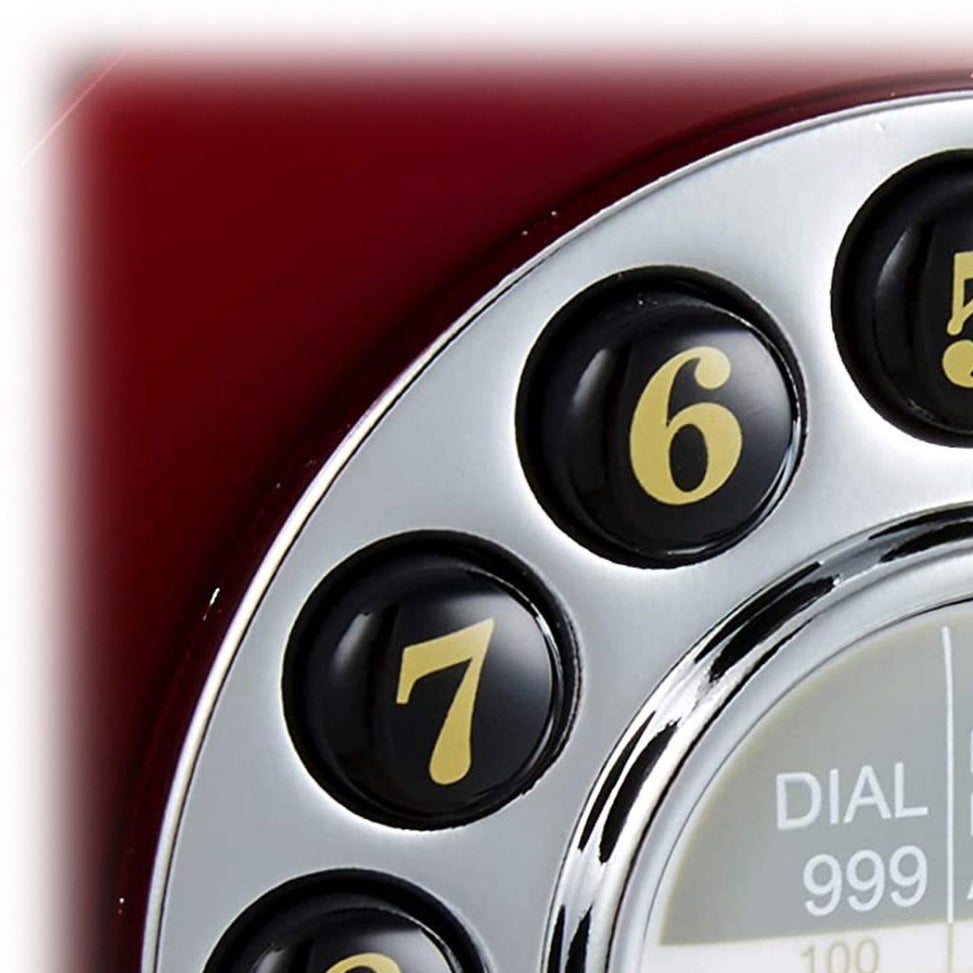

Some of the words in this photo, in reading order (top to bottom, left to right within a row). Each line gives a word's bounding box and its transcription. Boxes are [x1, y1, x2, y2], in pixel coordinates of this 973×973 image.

[629, 346, 743, 506] 6
[396, 619, 493, 785] 7
[775, 763, 928, 831] DIAL
[803, 846, 929, 918] 999
